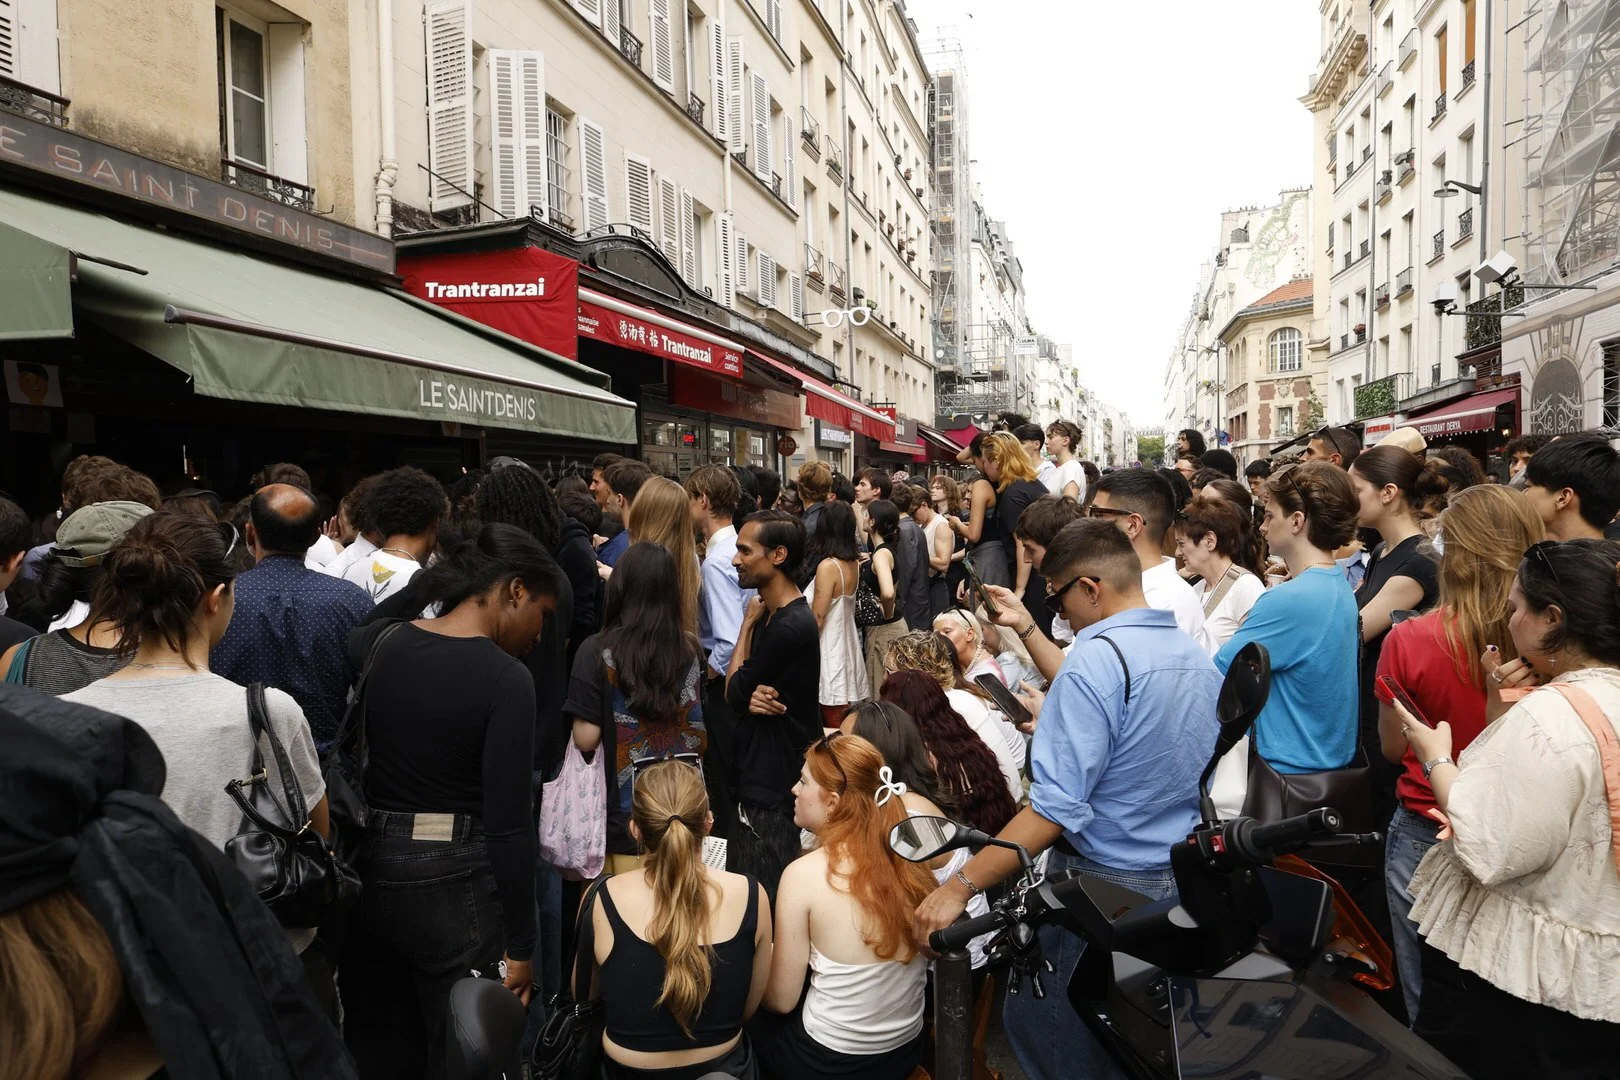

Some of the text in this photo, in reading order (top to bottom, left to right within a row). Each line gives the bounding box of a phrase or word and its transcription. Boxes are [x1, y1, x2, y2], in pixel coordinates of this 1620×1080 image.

[55, 144, 200, 208] SAINT
[223, 197, 333, 249] DENIS
[425, 277, 545, 298] Trantranzai
[661, 335, 711, 363] Trantranzai
[420, 379, 444, 408] LE
[1420, 420, 1461, 434] RESTAURANT DERYA
